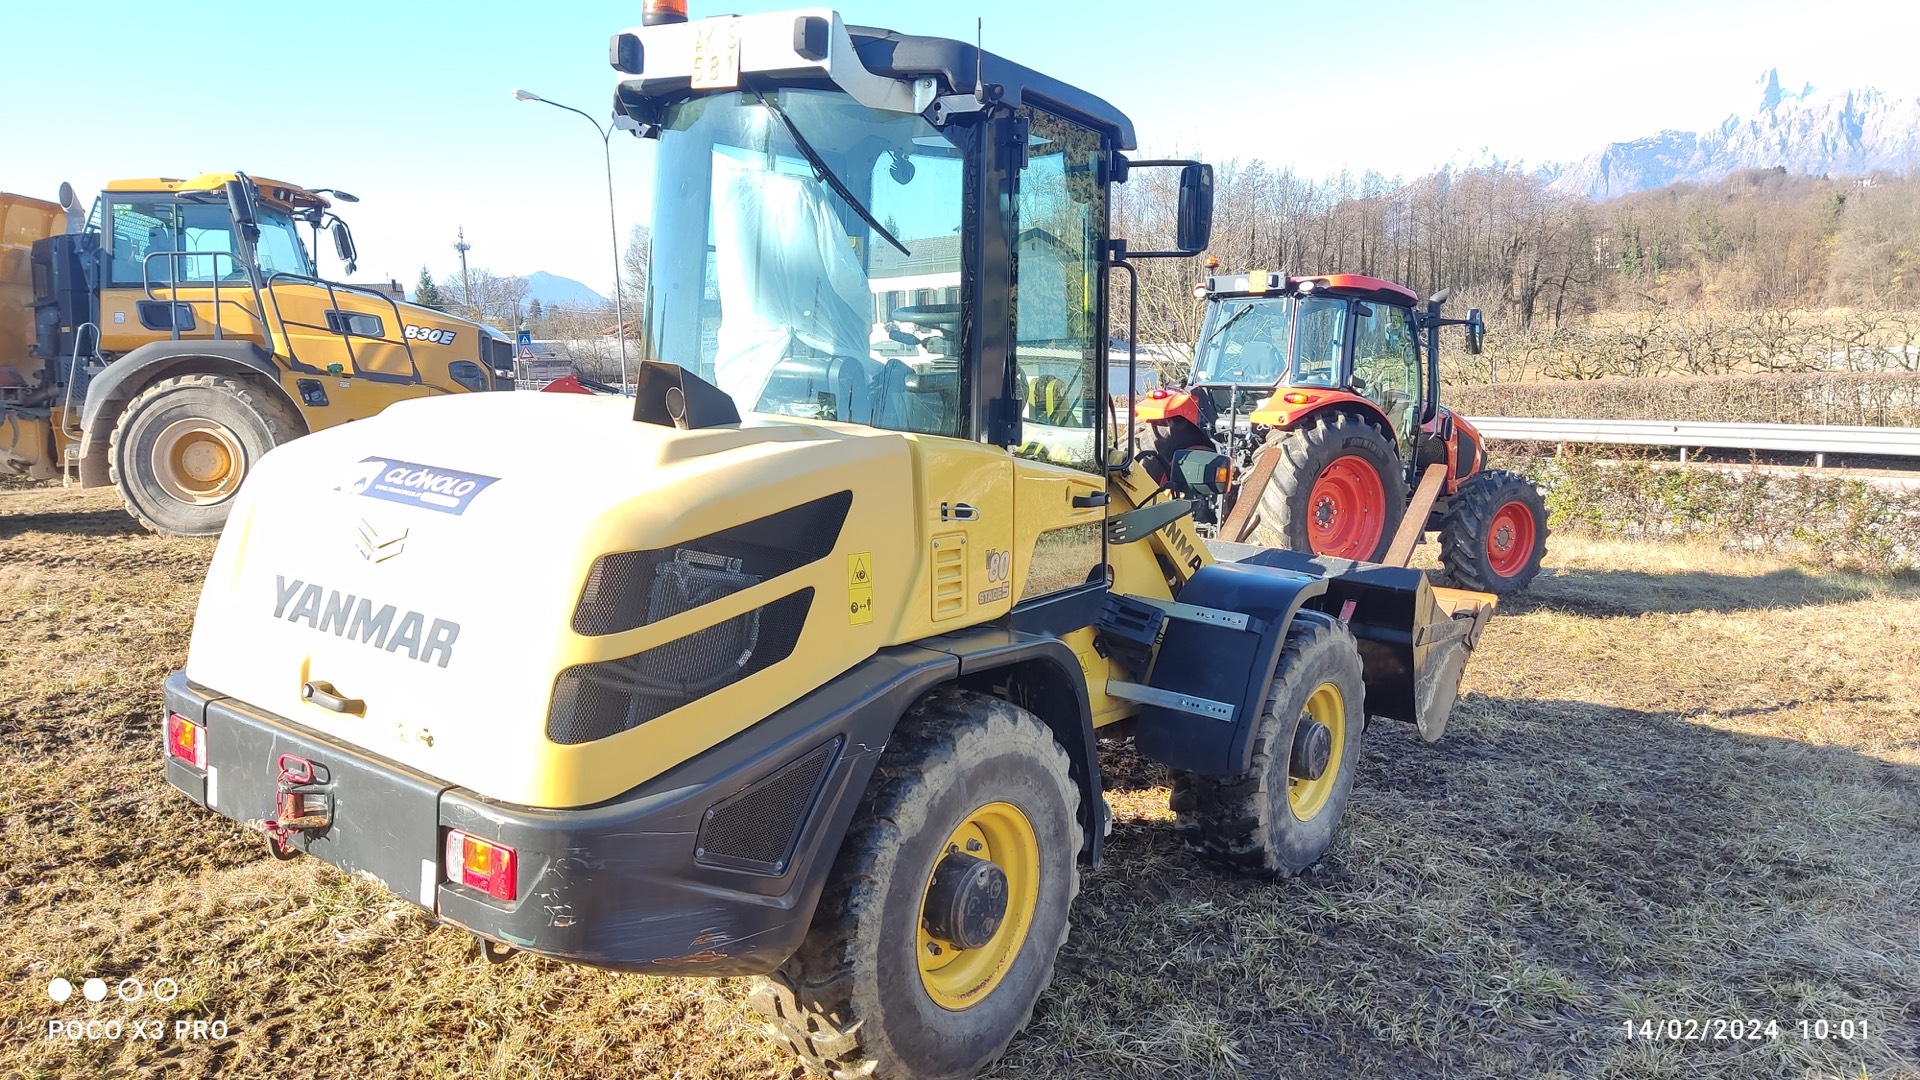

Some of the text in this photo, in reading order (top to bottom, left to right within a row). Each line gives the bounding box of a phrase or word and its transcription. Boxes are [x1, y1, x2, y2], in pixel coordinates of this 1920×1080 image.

[403, 324, 457, 346] B30E
[1161, 521, 1206, 572] NMA
[273, 574, 461, 669] YANMAR
